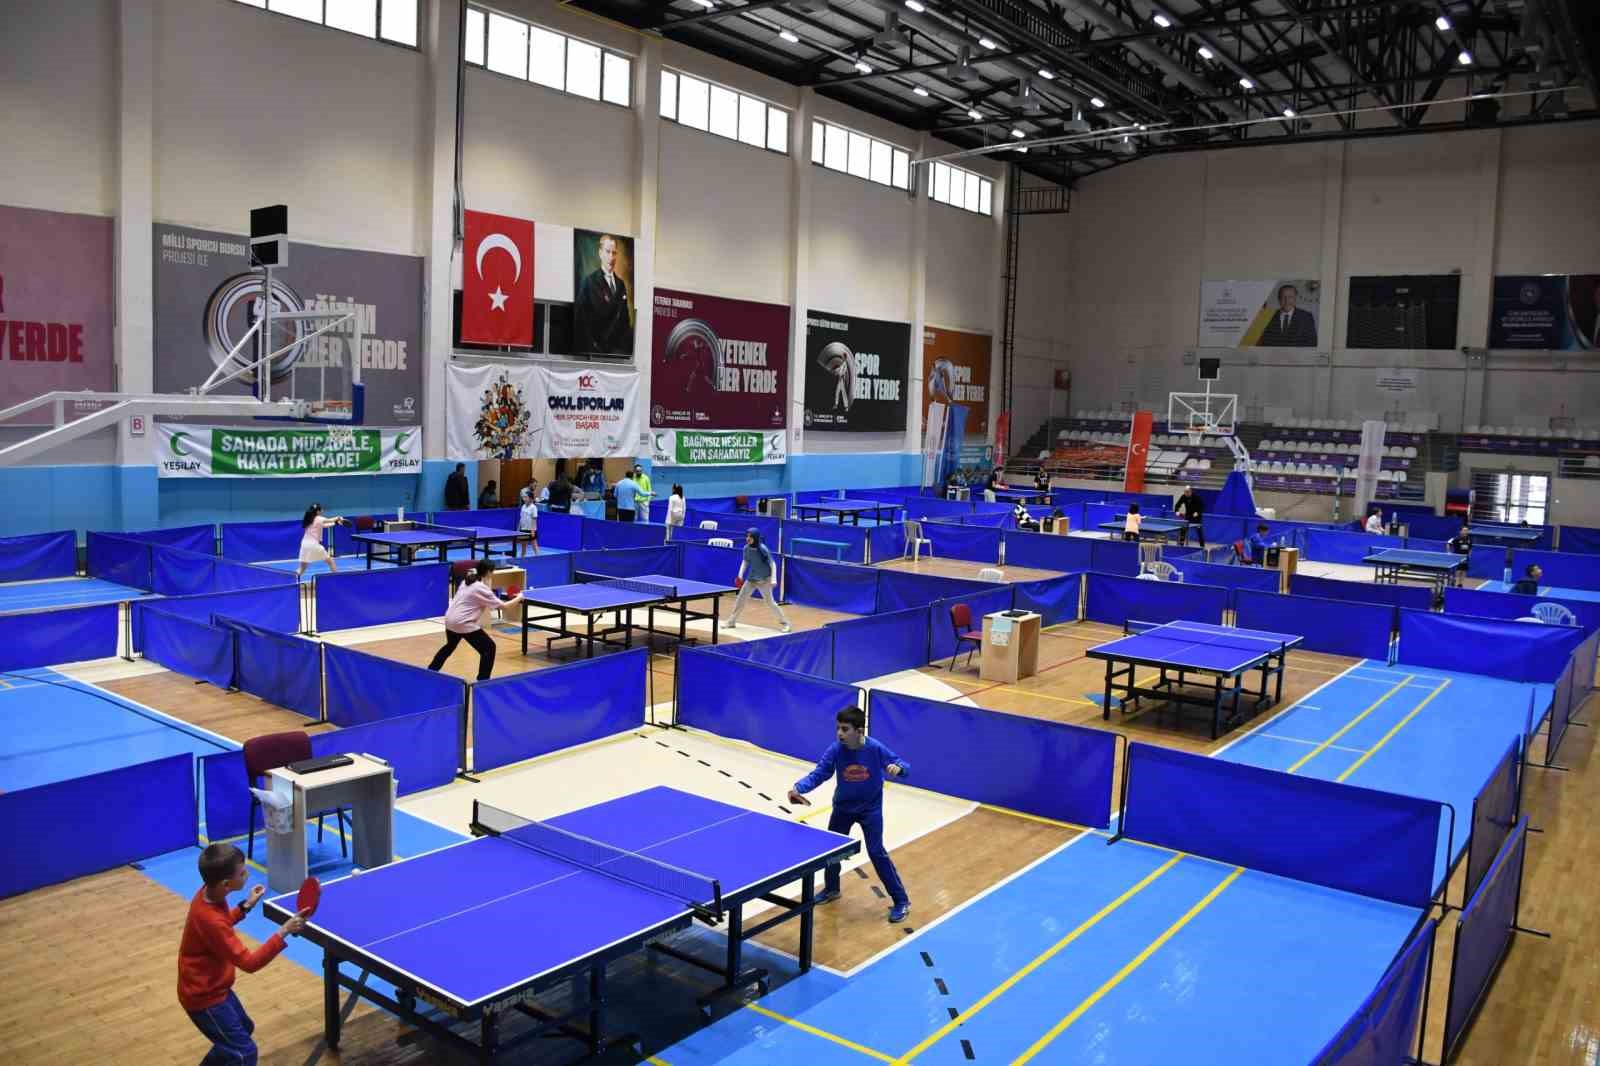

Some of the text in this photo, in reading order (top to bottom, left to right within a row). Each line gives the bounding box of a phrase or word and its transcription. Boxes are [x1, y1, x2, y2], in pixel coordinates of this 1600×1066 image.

[352, 338, 407, 371] ERDE
[718, 338, 767, 367] YETENEK
[854, 352, 880, 376] SPOR
[717, 366, 778, 394] HER YERDE
[853, 377, 900, 401] HER YERDE
[547, 396, 576, 411] OKUL
[132, 418, 143, 431] B
[221, 435, 289, 453] SAHADA
[237, 452, 307, 470] HAYATTA
